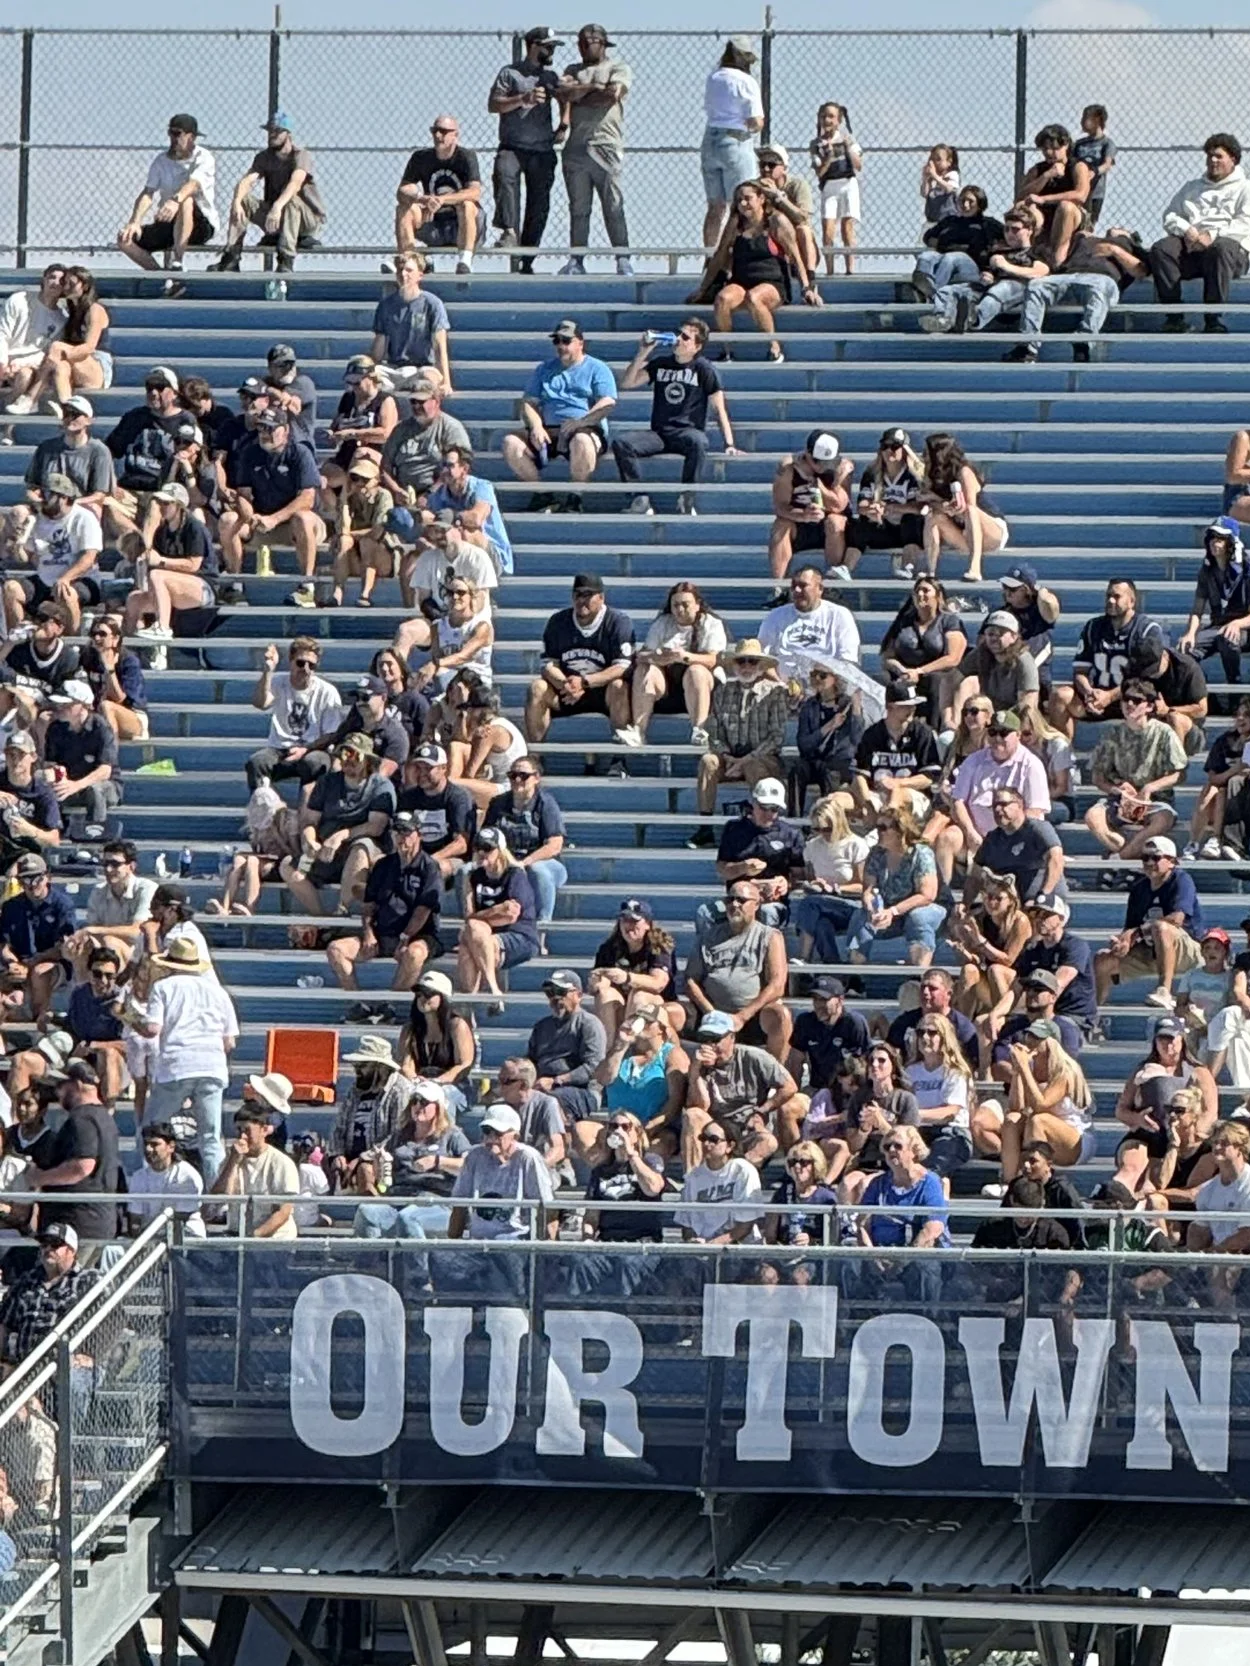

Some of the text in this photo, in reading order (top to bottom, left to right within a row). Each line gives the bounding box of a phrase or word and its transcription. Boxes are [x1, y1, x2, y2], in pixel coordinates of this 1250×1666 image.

[872, 752, 918, 768] NEVADA
[290, 1273, 644, 1458] OUR
[702, 1284, 1241, 1473] TOWN
